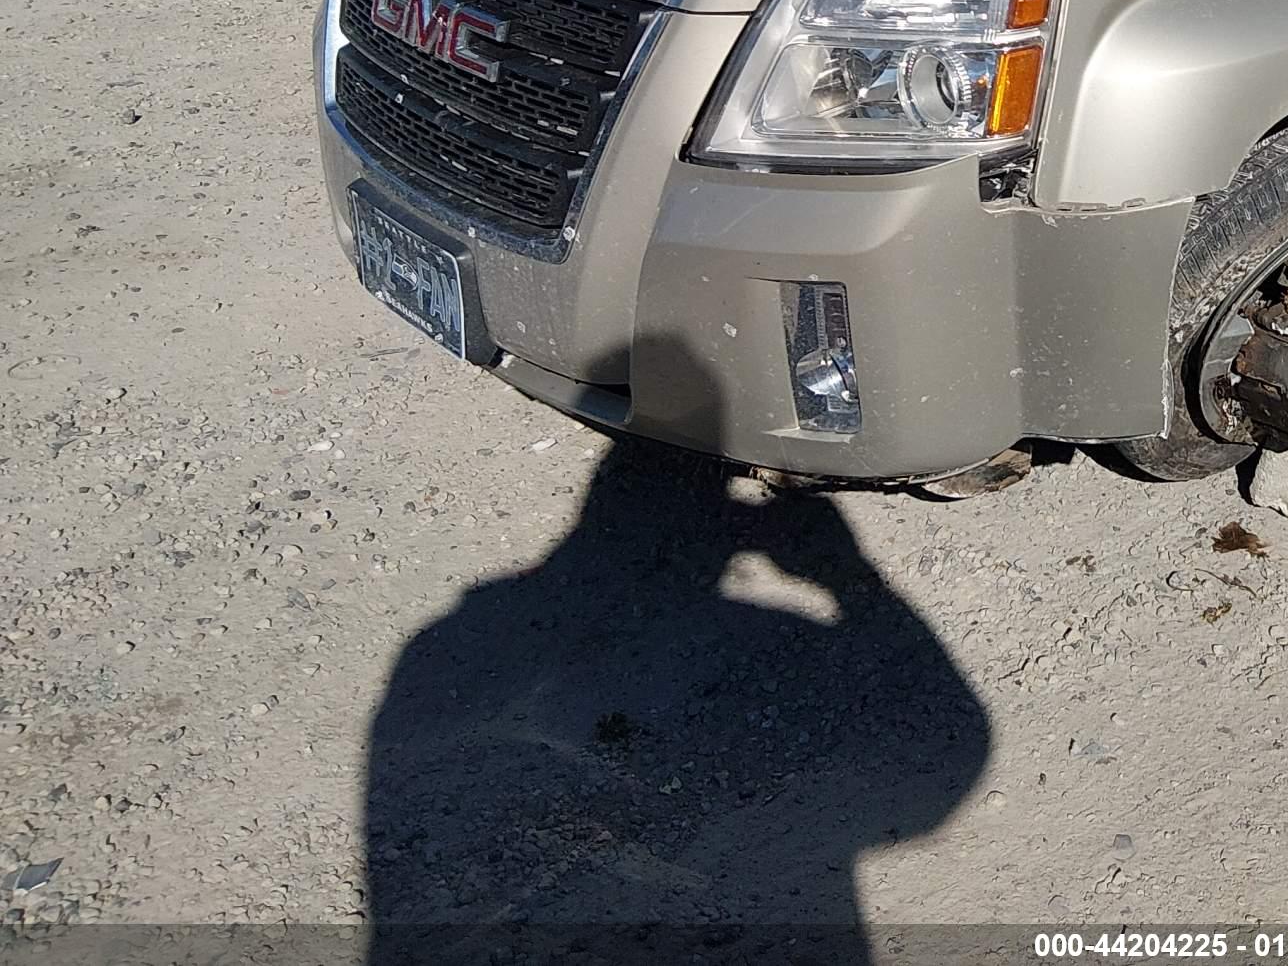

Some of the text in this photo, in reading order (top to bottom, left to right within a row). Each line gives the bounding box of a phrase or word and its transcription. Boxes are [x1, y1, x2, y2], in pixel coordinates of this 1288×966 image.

[360, 219, 462, 332] #1 FAN
[383, 289, 434, 333] SEAHAWKS
